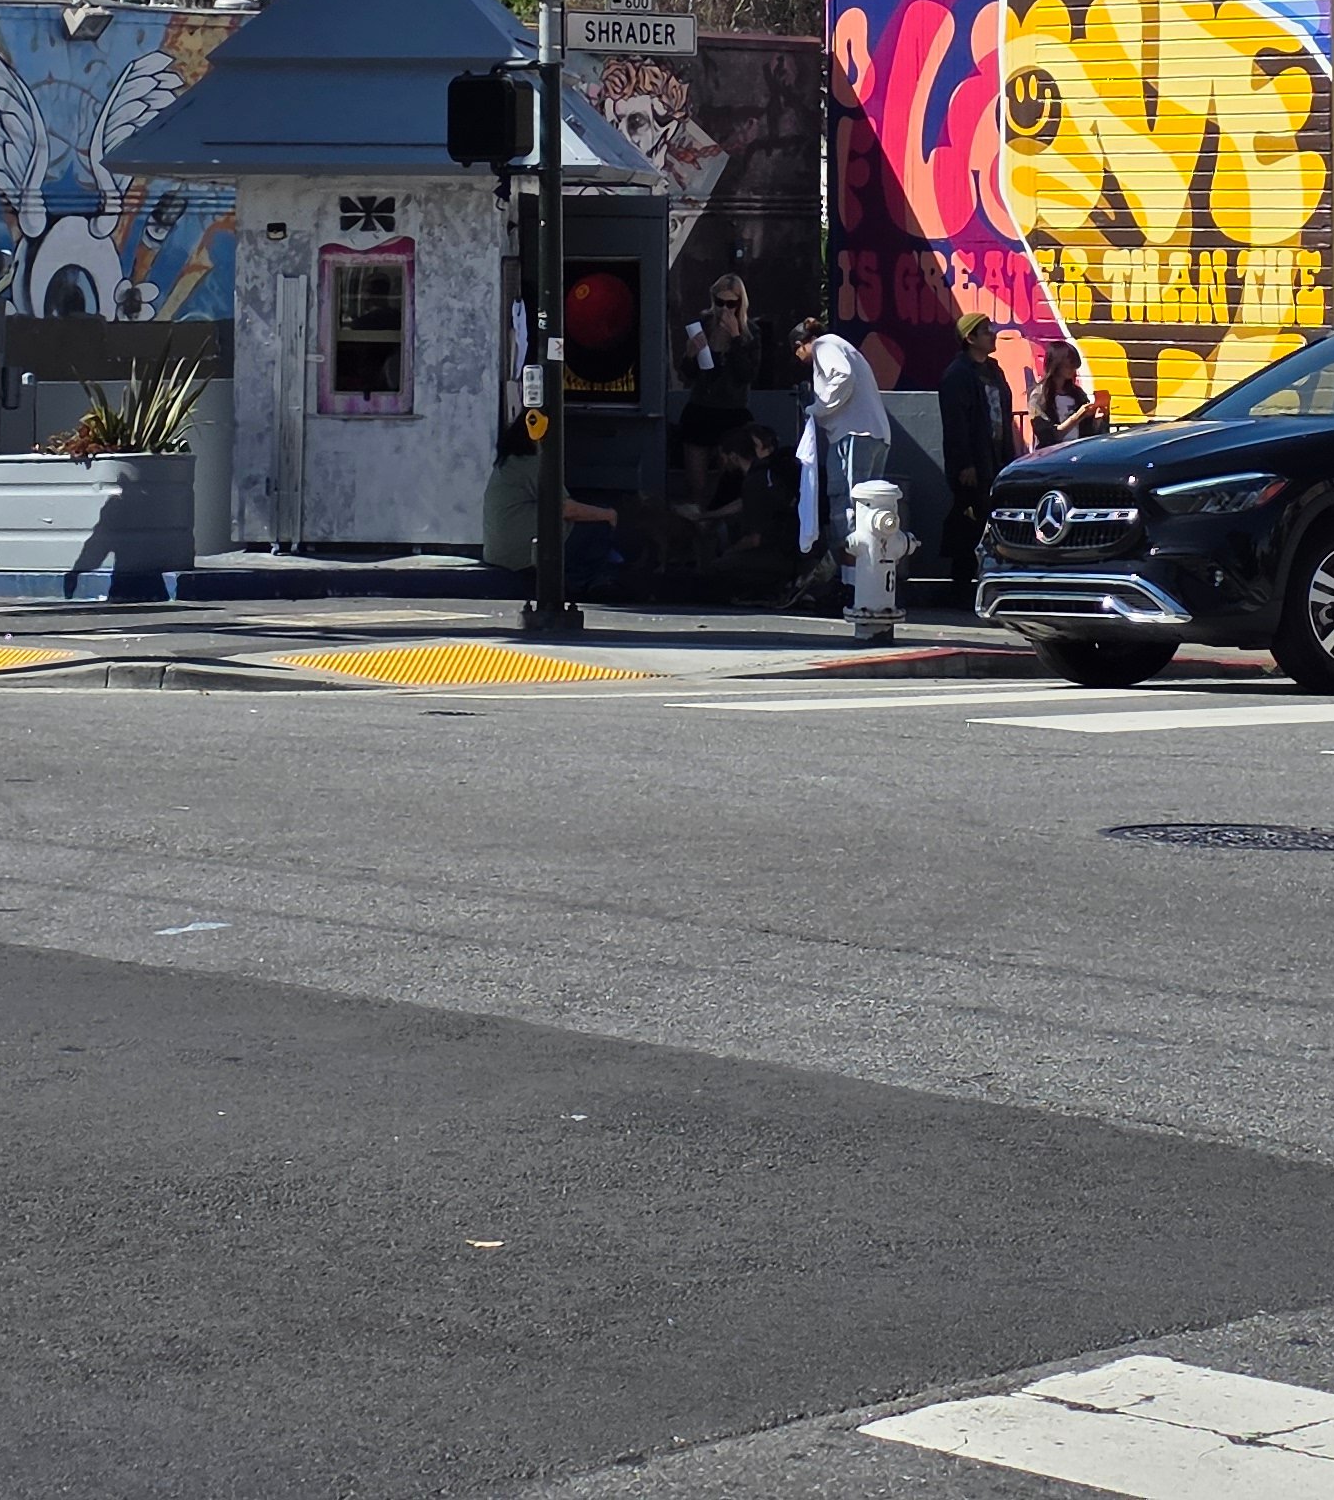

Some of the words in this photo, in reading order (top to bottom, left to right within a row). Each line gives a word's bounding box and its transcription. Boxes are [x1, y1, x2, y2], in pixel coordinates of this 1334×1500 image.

[584, 20, 677, 47] SHRADER
[838, 250, 884, 323] IS
[894, 249, 1094, 326] GREATER
[1102, 248, 1230, 325] THAN
[1237, 248, 1327, 326] THE
